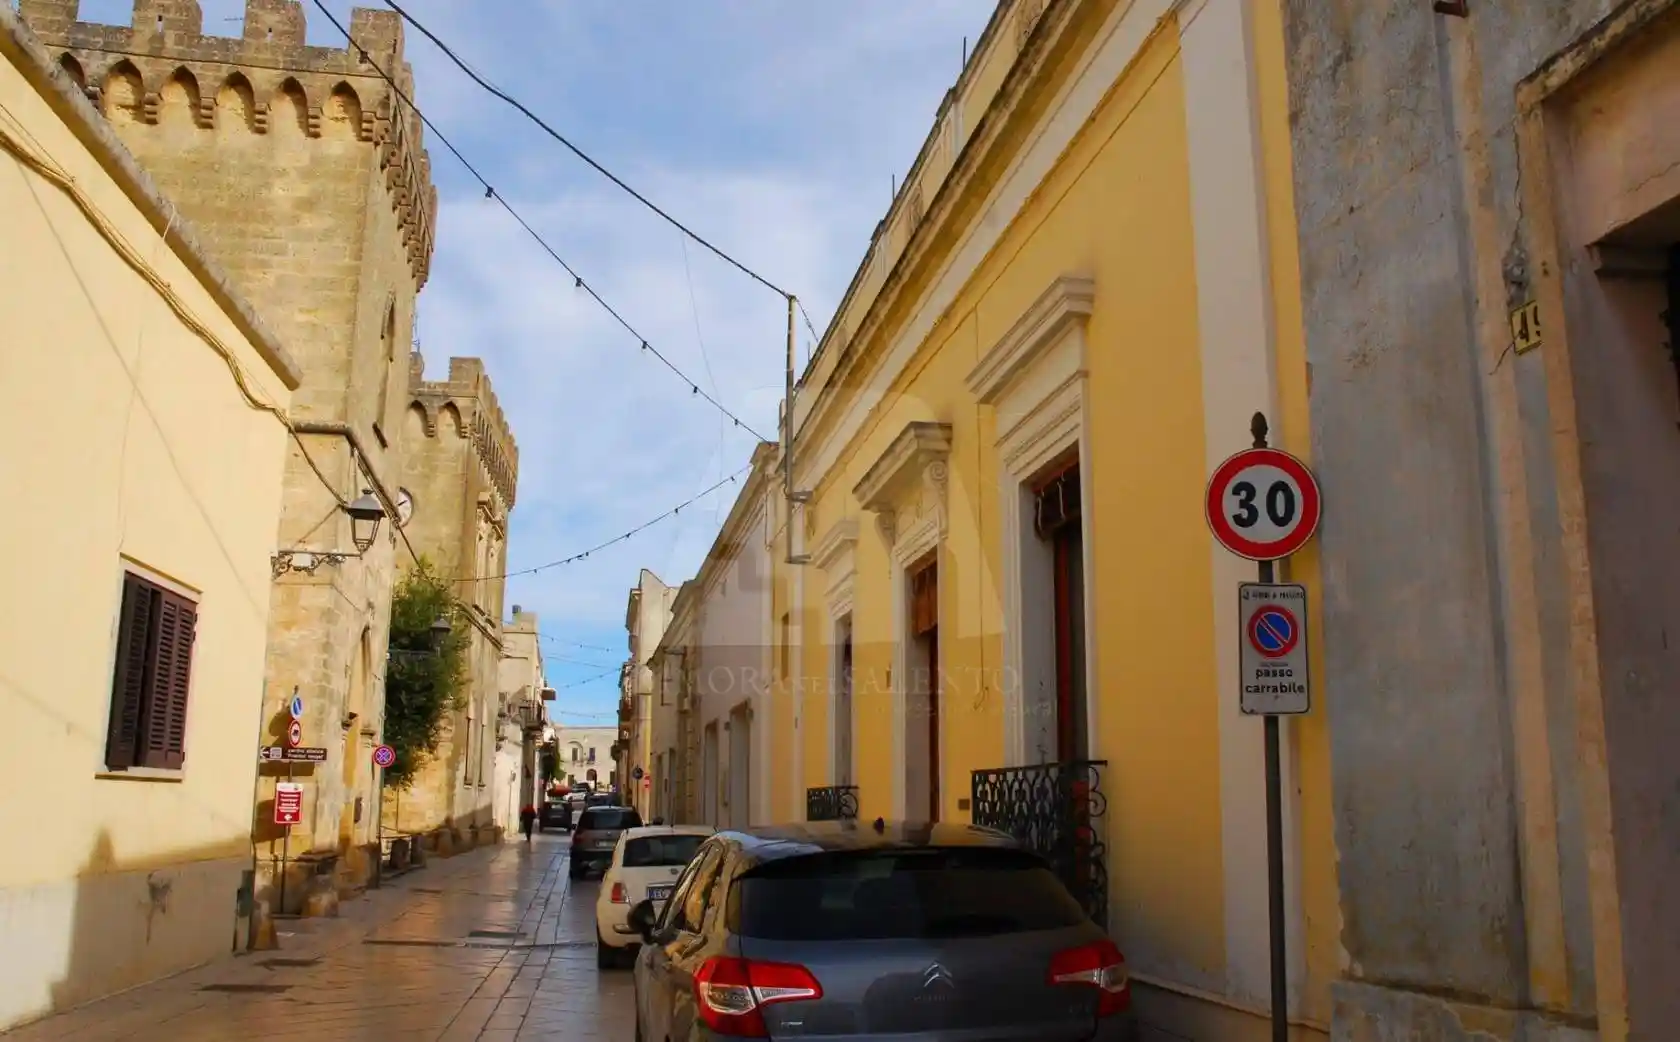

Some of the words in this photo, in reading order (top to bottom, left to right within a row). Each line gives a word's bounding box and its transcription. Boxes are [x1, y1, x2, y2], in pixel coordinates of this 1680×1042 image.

[1231, 480, 1296, 529] 30
[1255, 668, 1293, 680] passo
[1245, 681, 1305, 694] carrabile
